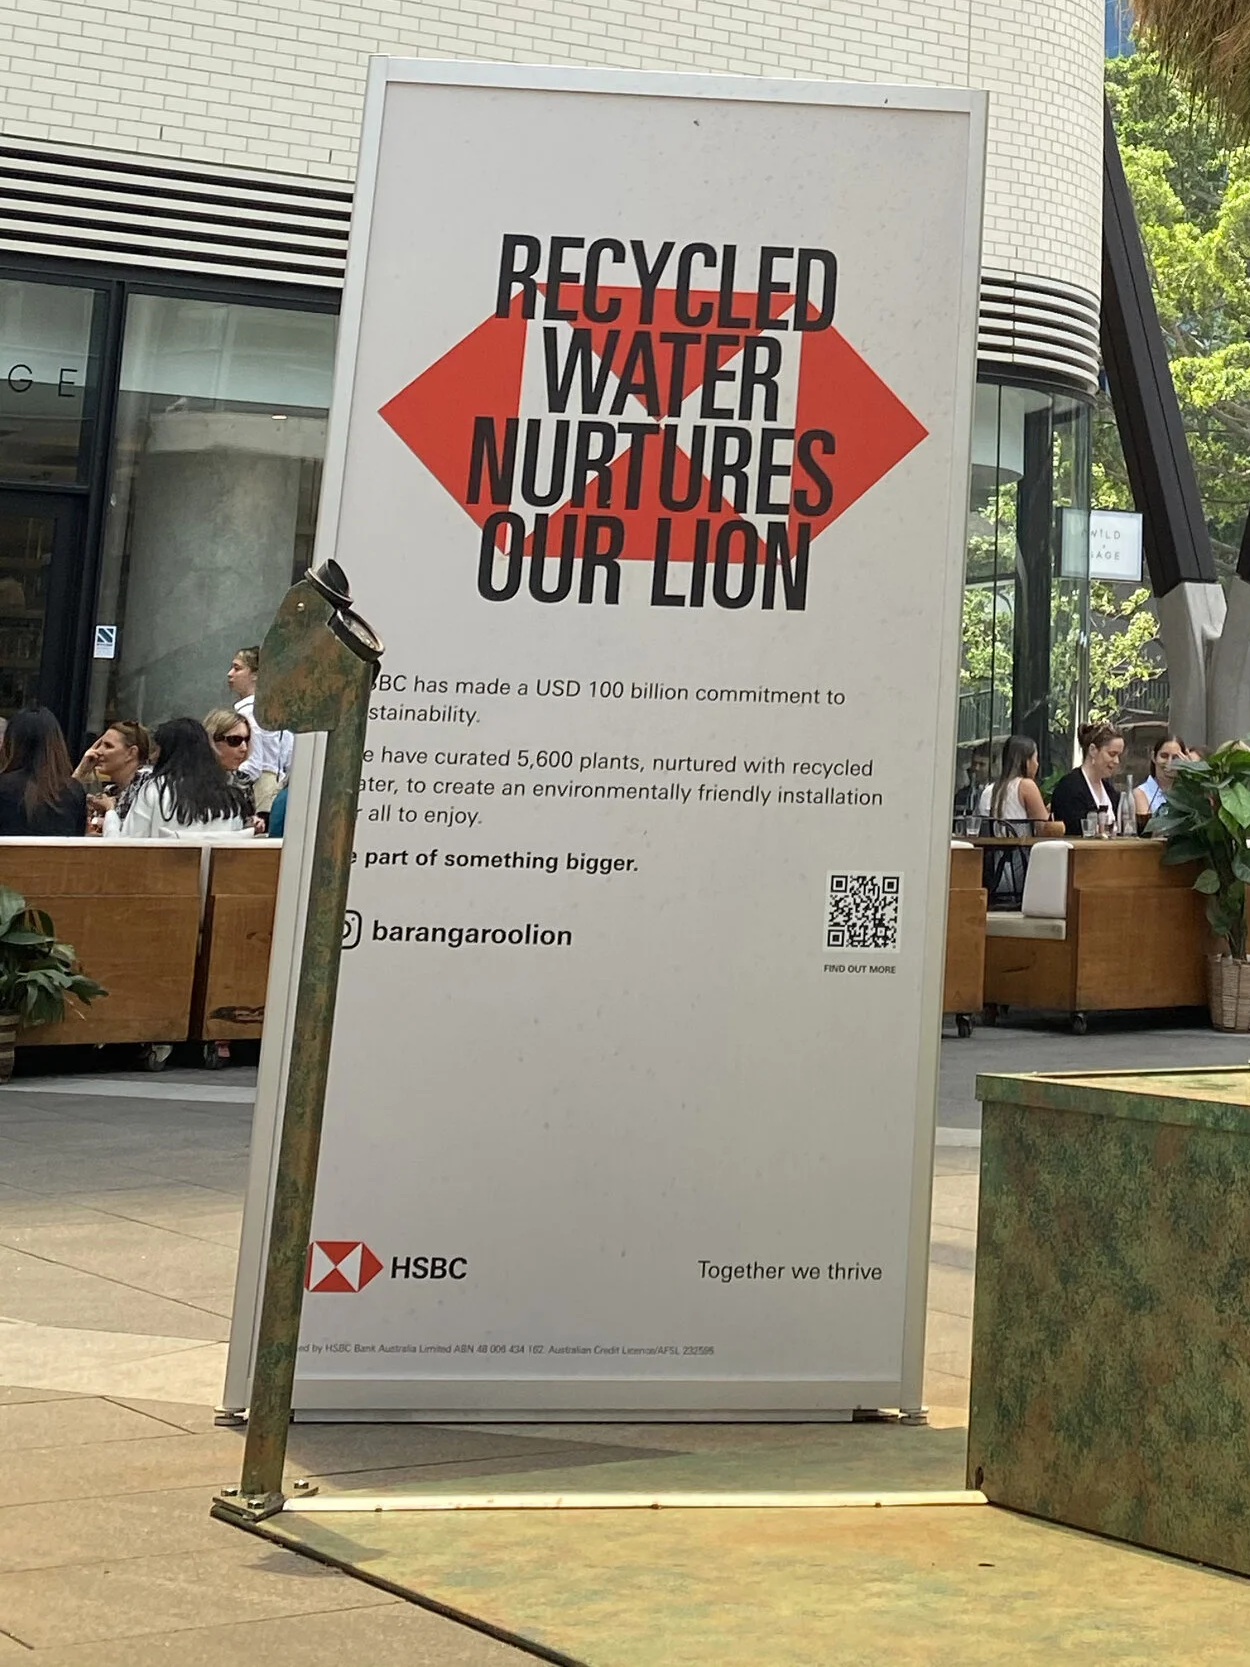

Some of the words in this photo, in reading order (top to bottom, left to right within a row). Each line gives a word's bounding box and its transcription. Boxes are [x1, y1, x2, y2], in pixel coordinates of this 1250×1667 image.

[494, 233, 838, 332] RECYCLED
[543, 327, 783, 422] WATER
[466, 416, 836, 517] NURTURES
[477, 511, 625, 605] OUR
[650, 517, 812, 611] LION
[371, 674, 407, 692] BC
[413, 675, 448, 694] has
[455, 677, 511, 696] made
[517, 682, 529, 696] a
[536, 678, 581, 697] USD
[589, 680, 624, 699] 100
[630, 682, 689, 701] billion
[695, 686, 821, 705] commitment
[826, 689, 846, 706] to
[368, 704, 480, 726] stainability.
[362, 749, 374, 763] e
[381, 745, 428, 765] have
[434, 749, 511, 767] curated
[517, 749, 573, 770] 5,600
[579, 751, 645, 773] plants,
[652, 755, 737, 773] nurtured
[743, 756, 785, 775] with
[792, 758, 874, 780] recycled
[359, 776, 399, 795] ater,
[406, 778, 427, 794] to
[432, 779, 495, 796] create
[501, 782, 526, 796] an
[532, 780, 692, 805] environmentally
[697, 783, 772, 807] friendly
[777, 786, 883, 806] installation
[368, 804, 392, 822] all
[398, 806, 418, 823] to
[424, 805, 482, 828] enjoy.
[364, 850, 409, 869] part
[415, 848, 439, 866] of
[444, 851, 559, 874] something
[566, 852, 638, 875] bigger.
[372, 919, 572, 949] barangaroolion
[823, 964, 846, 973] FIND
[847, 964, 868, 974] OUT
[869, 965, 896, 975] MORE
[390, 1256, 468, 1280] HSBC
[697, 1260, 786, 1284] Together
[791, 1266, 821, 1280] we
[827, 1261, 883, 1281] thrive
[311, 1343, 324, 1355] by
[325, 1343, 352, 1353] HSBC
[353, 1343, 377, 1354] Bank
[377, 1343, 417, 1354] Australia
[418, 1344, 452, 1354] Limited
[547, 1345, 592, 1355] Australian
